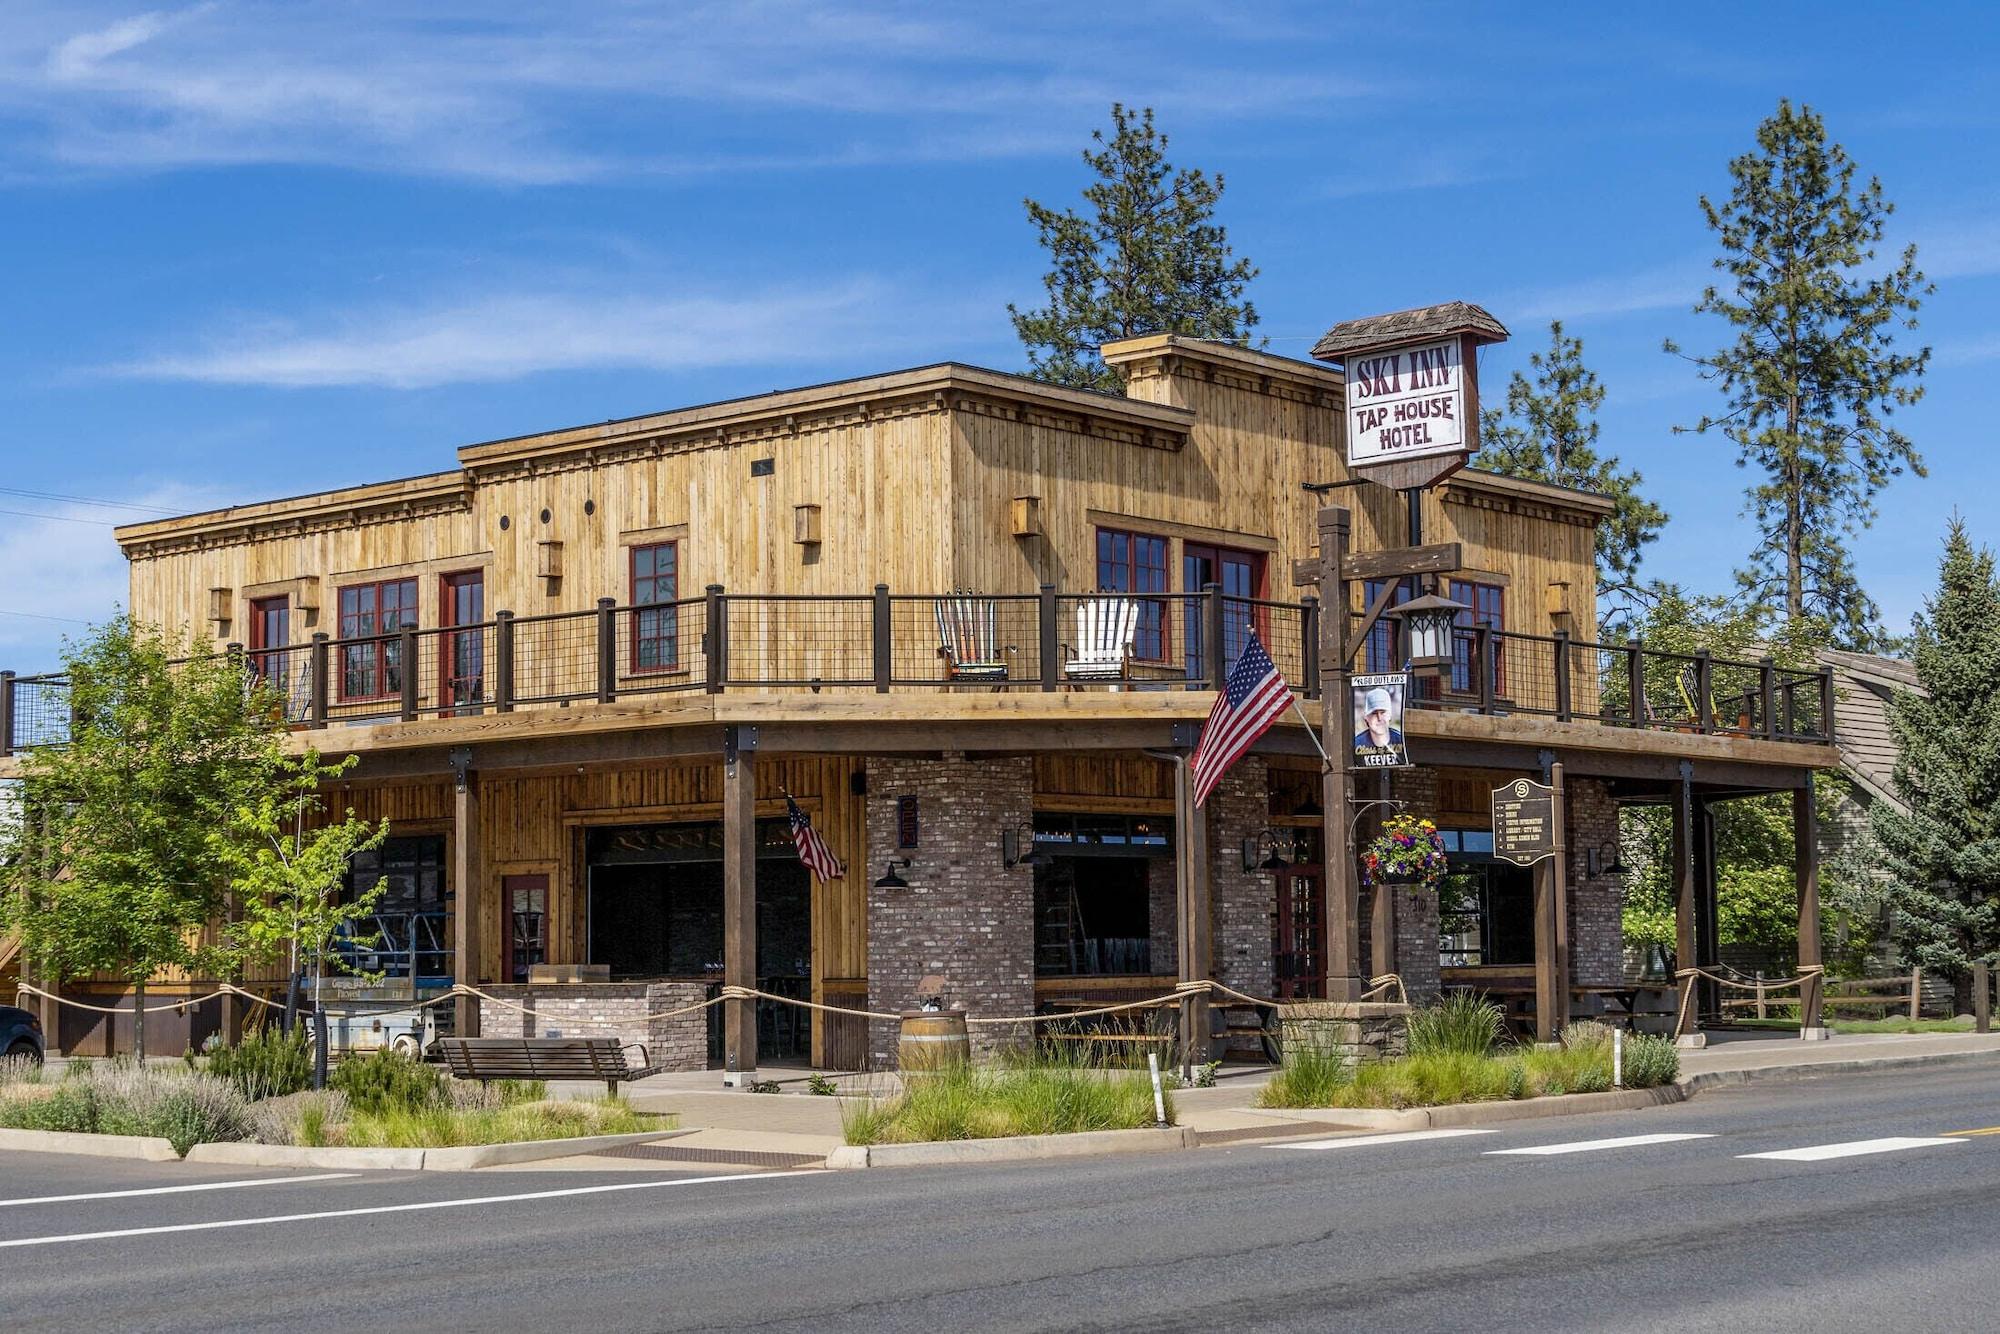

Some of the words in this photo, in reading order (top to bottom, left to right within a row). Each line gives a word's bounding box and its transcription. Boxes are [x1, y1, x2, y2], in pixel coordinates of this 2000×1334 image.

[1357, 354, 1401, 398] SKI
[1409, 345, 1450, 391] INN
[1356, 407, 1388, 434] TAP
[1394, 396, 1454, 422] HOUSE
[1380, 423, 1432, 450] HOTEL
[1373, 674, 1405, 685] OUTLAWS
[1364, 754, 1398, 766] KEEVER
